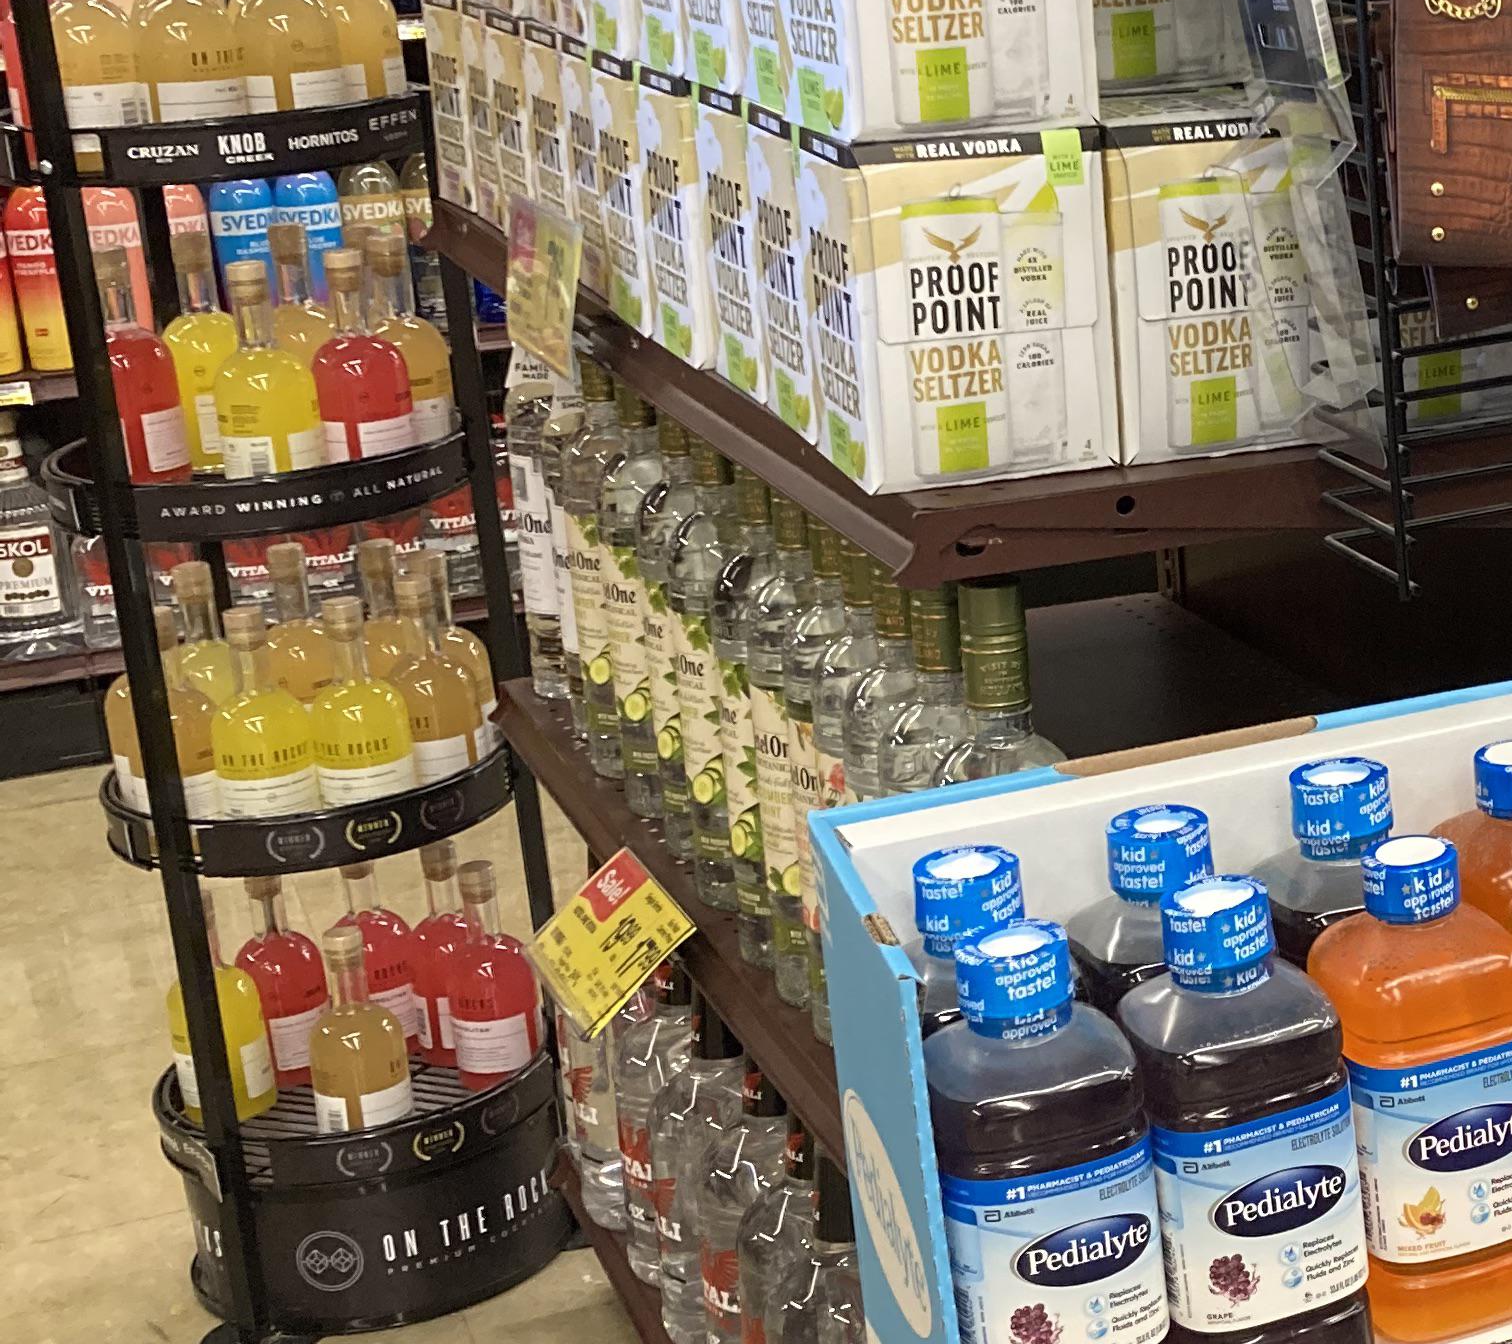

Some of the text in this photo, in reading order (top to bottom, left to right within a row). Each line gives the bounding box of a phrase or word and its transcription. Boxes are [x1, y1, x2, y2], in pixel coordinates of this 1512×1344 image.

[890, 10, 985, 44] SELTZER
[925, 61, 962, 78] LIME
[127, 110, 417, 160] CRUZAN KNOB HORNITOS EFFEN
[916, 138, 1022, 159] REAL VODKA
[1049, 159, 1080, 173] LIME
[278, 209, 341, 228] SVEDKA
[909, 261, 1000, 300] PROOF
[912, 296, 1003, 336] POINT
[909, 338, 1003, 376] VODKA
[912, 367, 1004, 403] SELTZER
[945, 416, 982, 432] LIME
[160, 466, 443, 519] AWARD WINNING ALL NATURAL
[1113, 859, 1165, 876] approved
[1121, 845, 1146, 863] kid
[1119, 875, 1164, 890] taste!
[1203, 1103, 1340, 1154] #1 PHARMACIST PEDIATRICIAN
[1225, 1173, 1343, 1227] Pedialyte
[382, 1229, 417, 1262] ON
[439, 1205, 488, 1247] THE
[1027, 1221, 1150, 1276] Pedialyte
